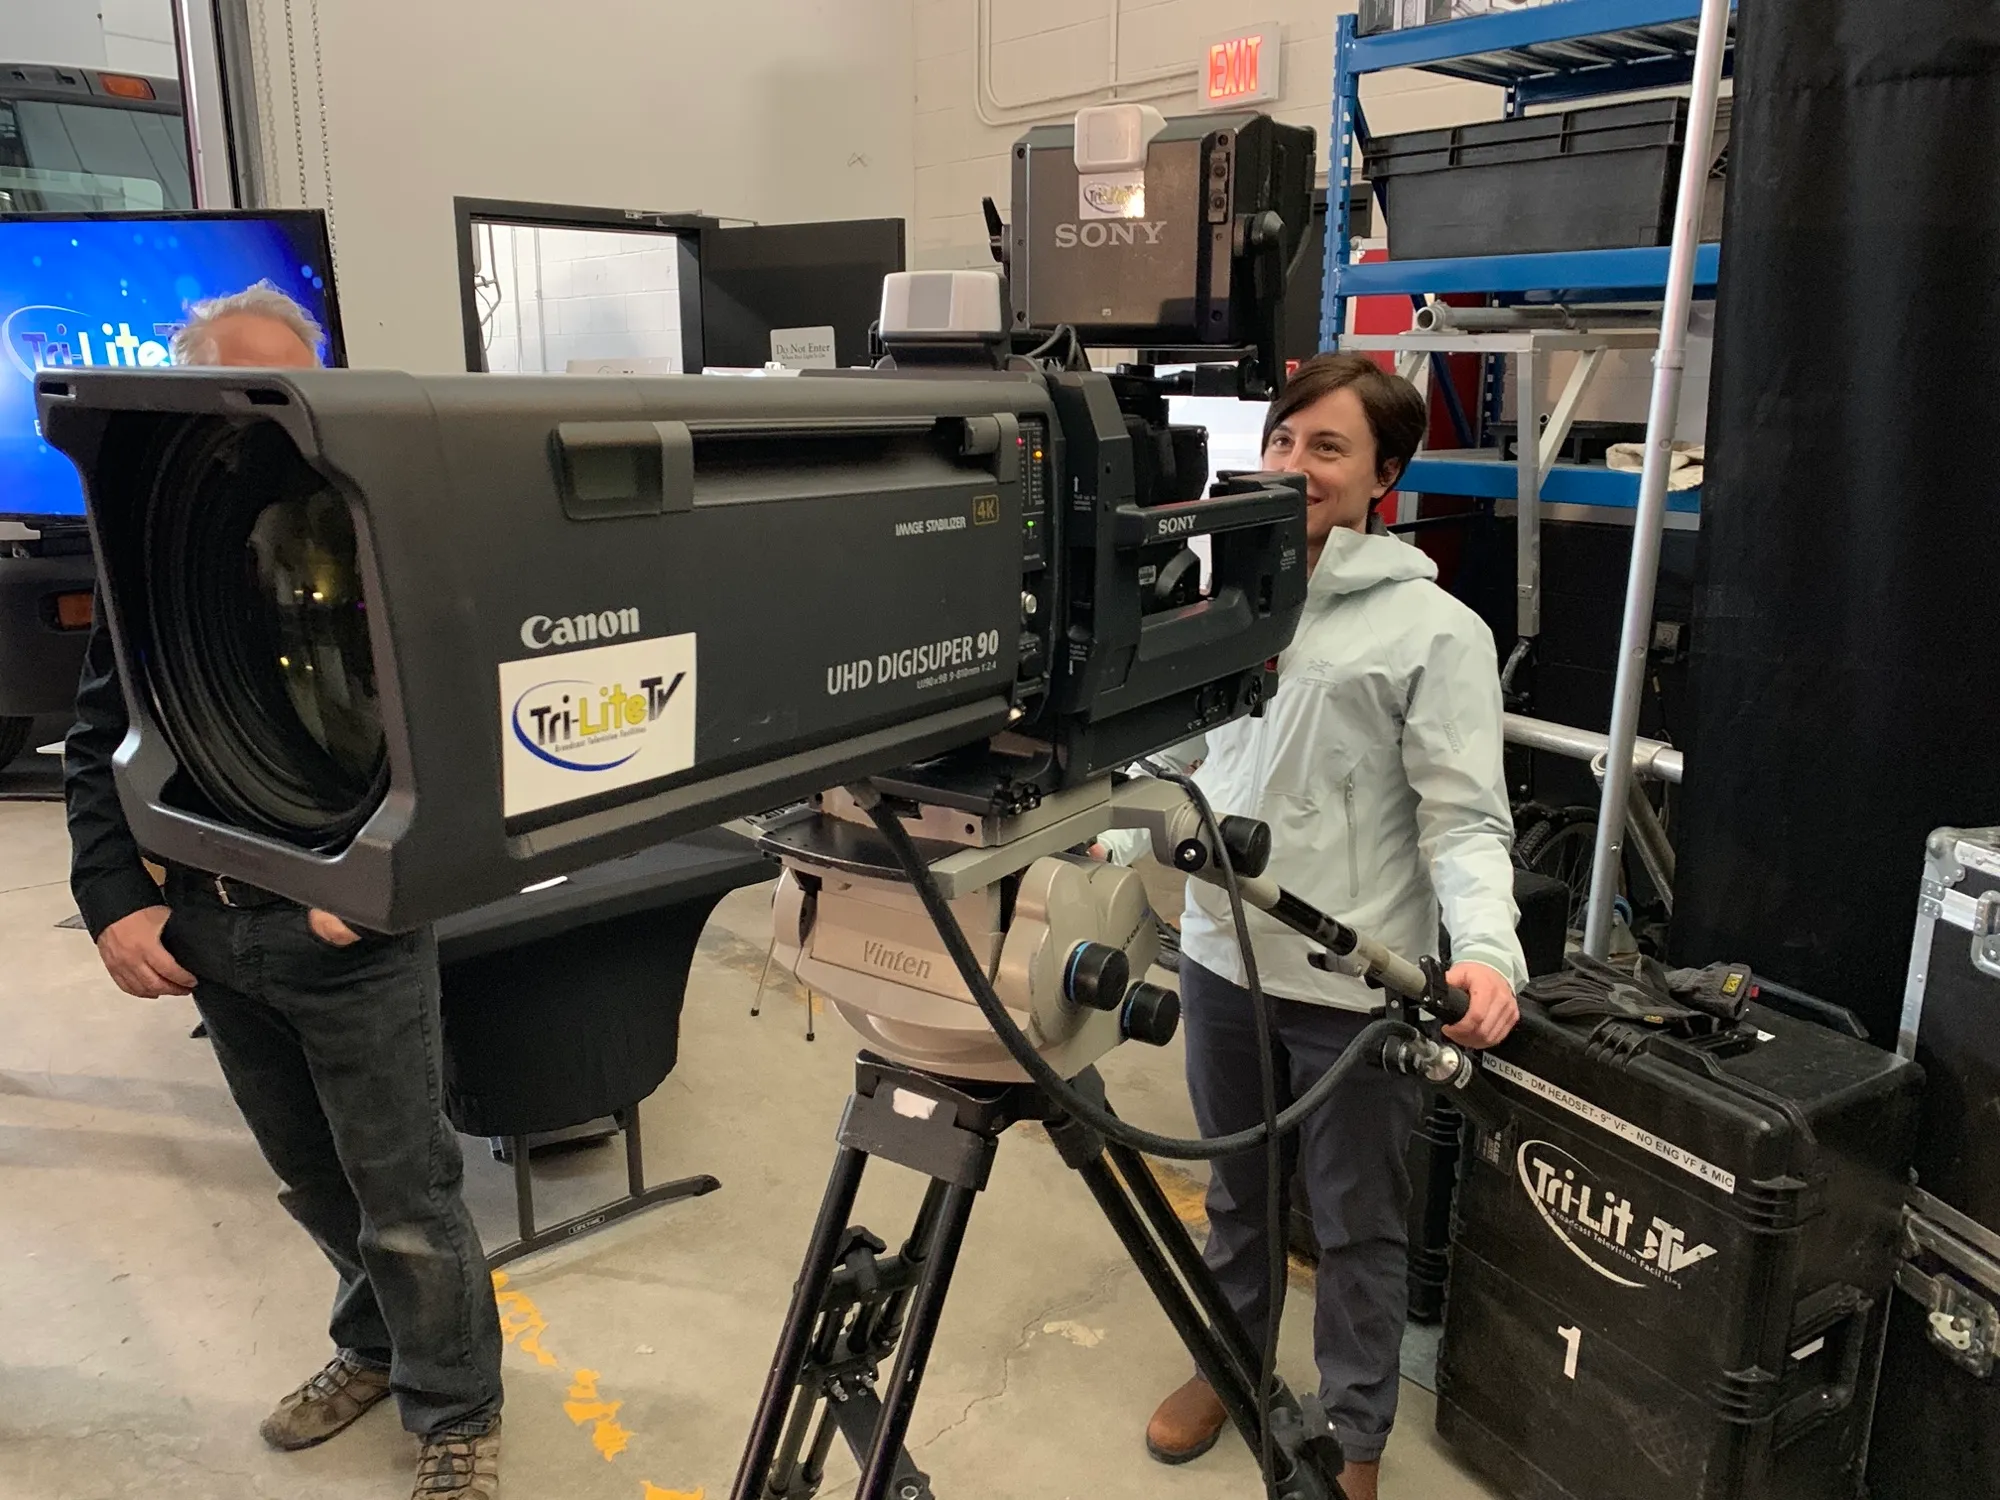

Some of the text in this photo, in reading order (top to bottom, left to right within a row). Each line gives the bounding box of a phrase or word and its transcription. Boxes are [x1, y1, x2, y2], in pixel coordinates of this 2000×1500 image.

[1209, 35, 1262, 98] EXIT
[1055, 221, 1167, 248] SONY
[776, 342, 831, 355] Do Not Enter
[895, 516, 967, 536] IMAGE STABILIZER
[977, 499, 996, 520] 4K
[1158, 514, 1197, 535] SONY
[520, 607, 640, 650] Canon
[827, 629, 999, 695] UHD DIGISUPER 90
[530, 671, 687, 746] Tri-LiteTV
[864, 940, 932, 979] Vinten
[1483, 1055, 1497, 1069] NO
[1499, 1061, 1524, 1082] LENS
[1530, 1079, 1546, 1093] DM
[1613, 1119, 1628, 1133] VF
[1636, 1131, 1653, 1147] NO
[1655, 1141, 1679, 1160] ENG
[1682, 1154, 1698, 1169] VF
[1699, 1163, 1708, 1176] &
[1711, 1169, 1734, 1189] MIC
[1550, 1207, 1591, 1238] Broadcast
[1593, 1231, 1637, 1264] Television
[1557, 1325, 1581, 1380] 1
